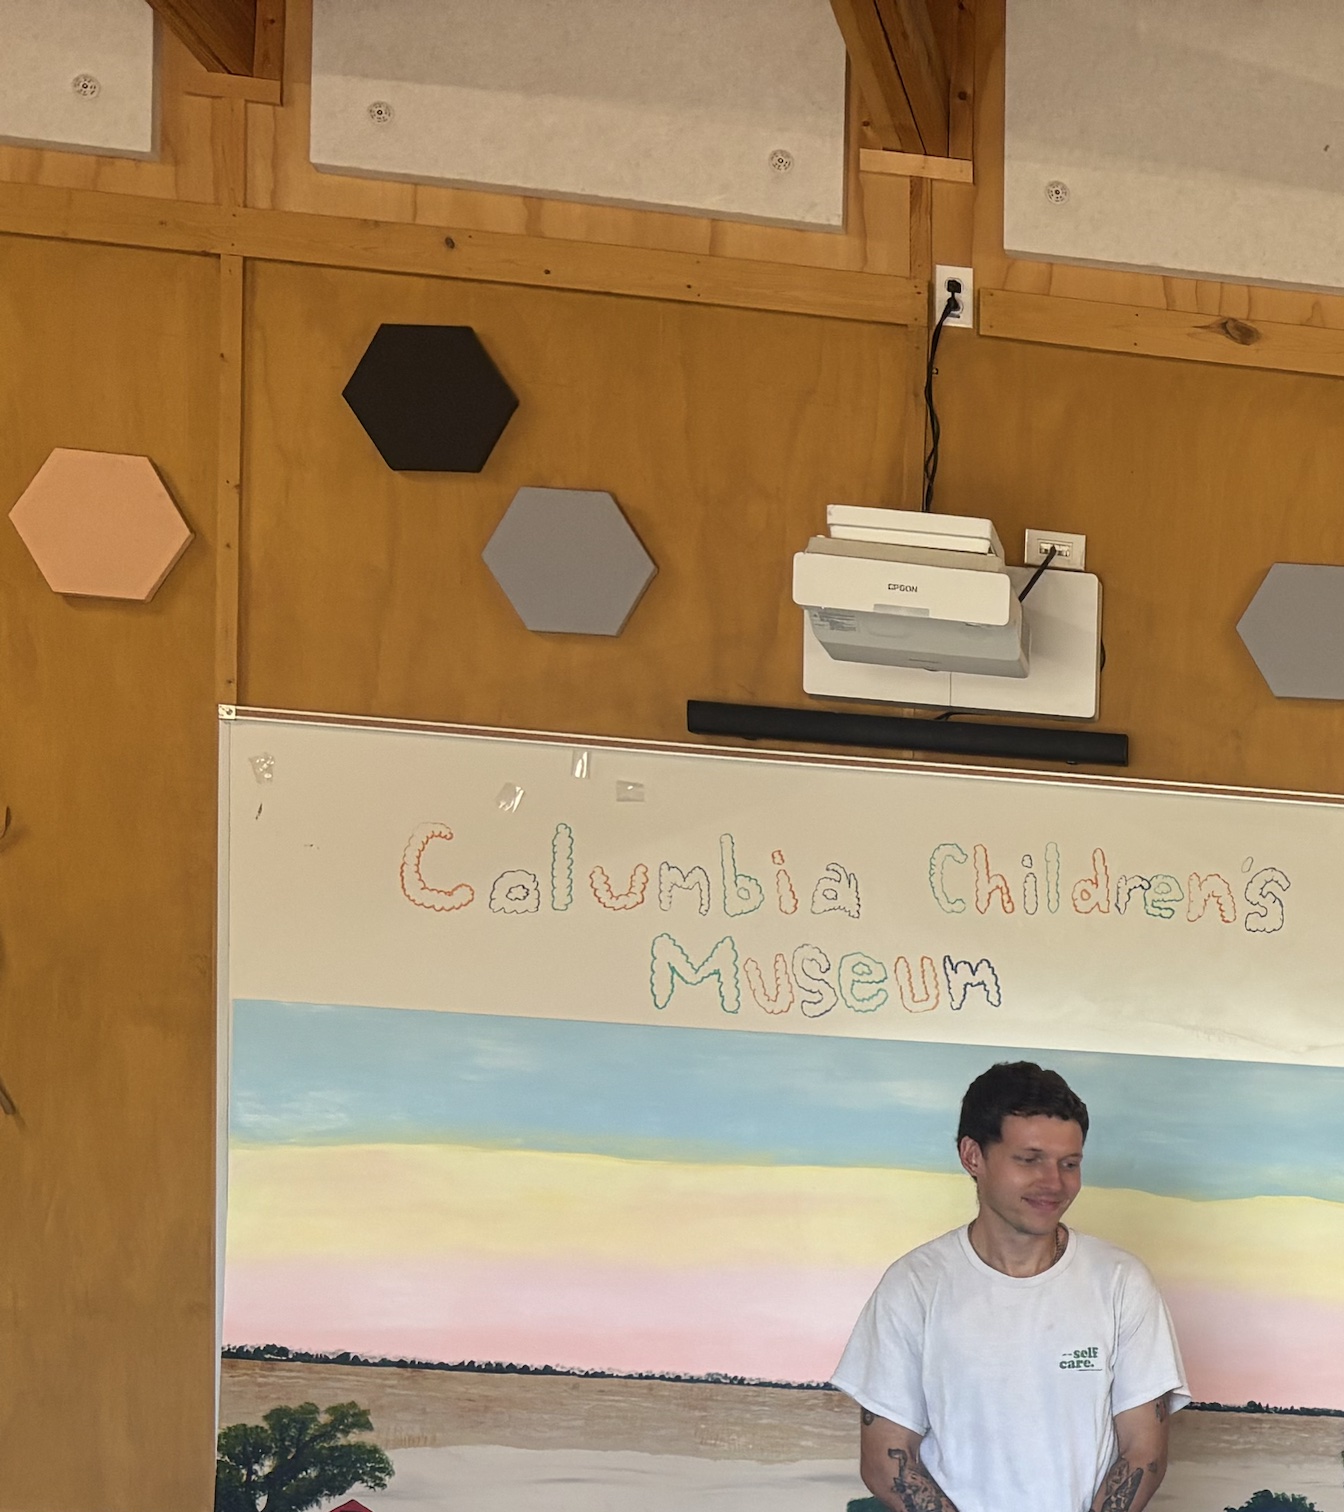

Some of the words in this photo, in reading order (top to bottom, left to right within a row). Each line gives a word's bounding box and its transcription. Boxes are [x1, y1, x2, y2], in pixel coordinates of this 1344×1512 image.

[887, 583, 918, 593] EPSON
[929, 841, 1291, 934] Children's
[650, 932, 1002, 1019] Museum
[1073, 1346, 1099, 1359] self
[1059, 1360, 1095, 1369] care.
